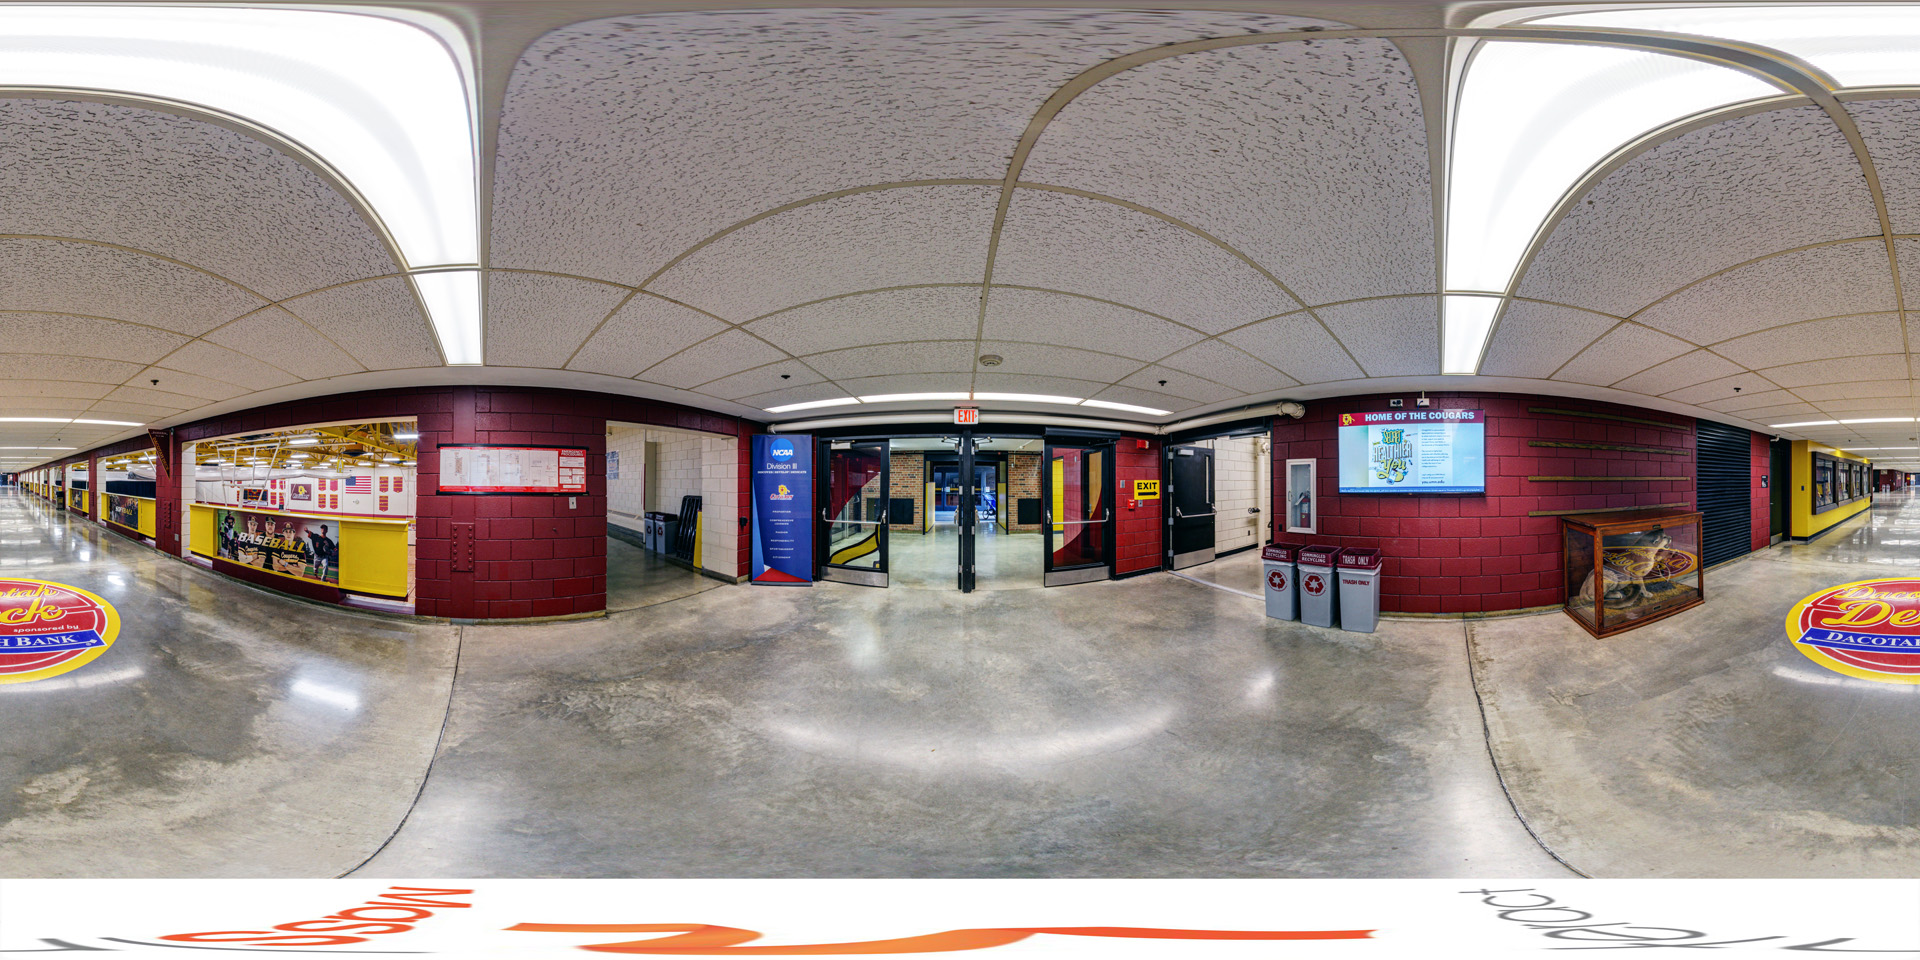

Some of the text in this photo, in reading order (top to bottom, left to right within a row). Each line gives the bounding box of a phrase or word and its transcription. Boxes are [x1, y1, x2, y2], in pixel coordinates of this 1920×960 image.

[958, 409, 976, 423] EXIT
[1365, 411, 1475, 422] HOME OF THE COUGARS
[1373, 443, 1413, 462] HEALTHIER
[766, 462, 791, 470] Division
[1136, 482, 1158, 490] EXIT
[238, 531, 305, 554] BASEBALL
[1342, 555, 1370, 566] TRASH ONLY
[13, 625, 65, 634] sponsored
[16, 635, 78, 647] BANK
